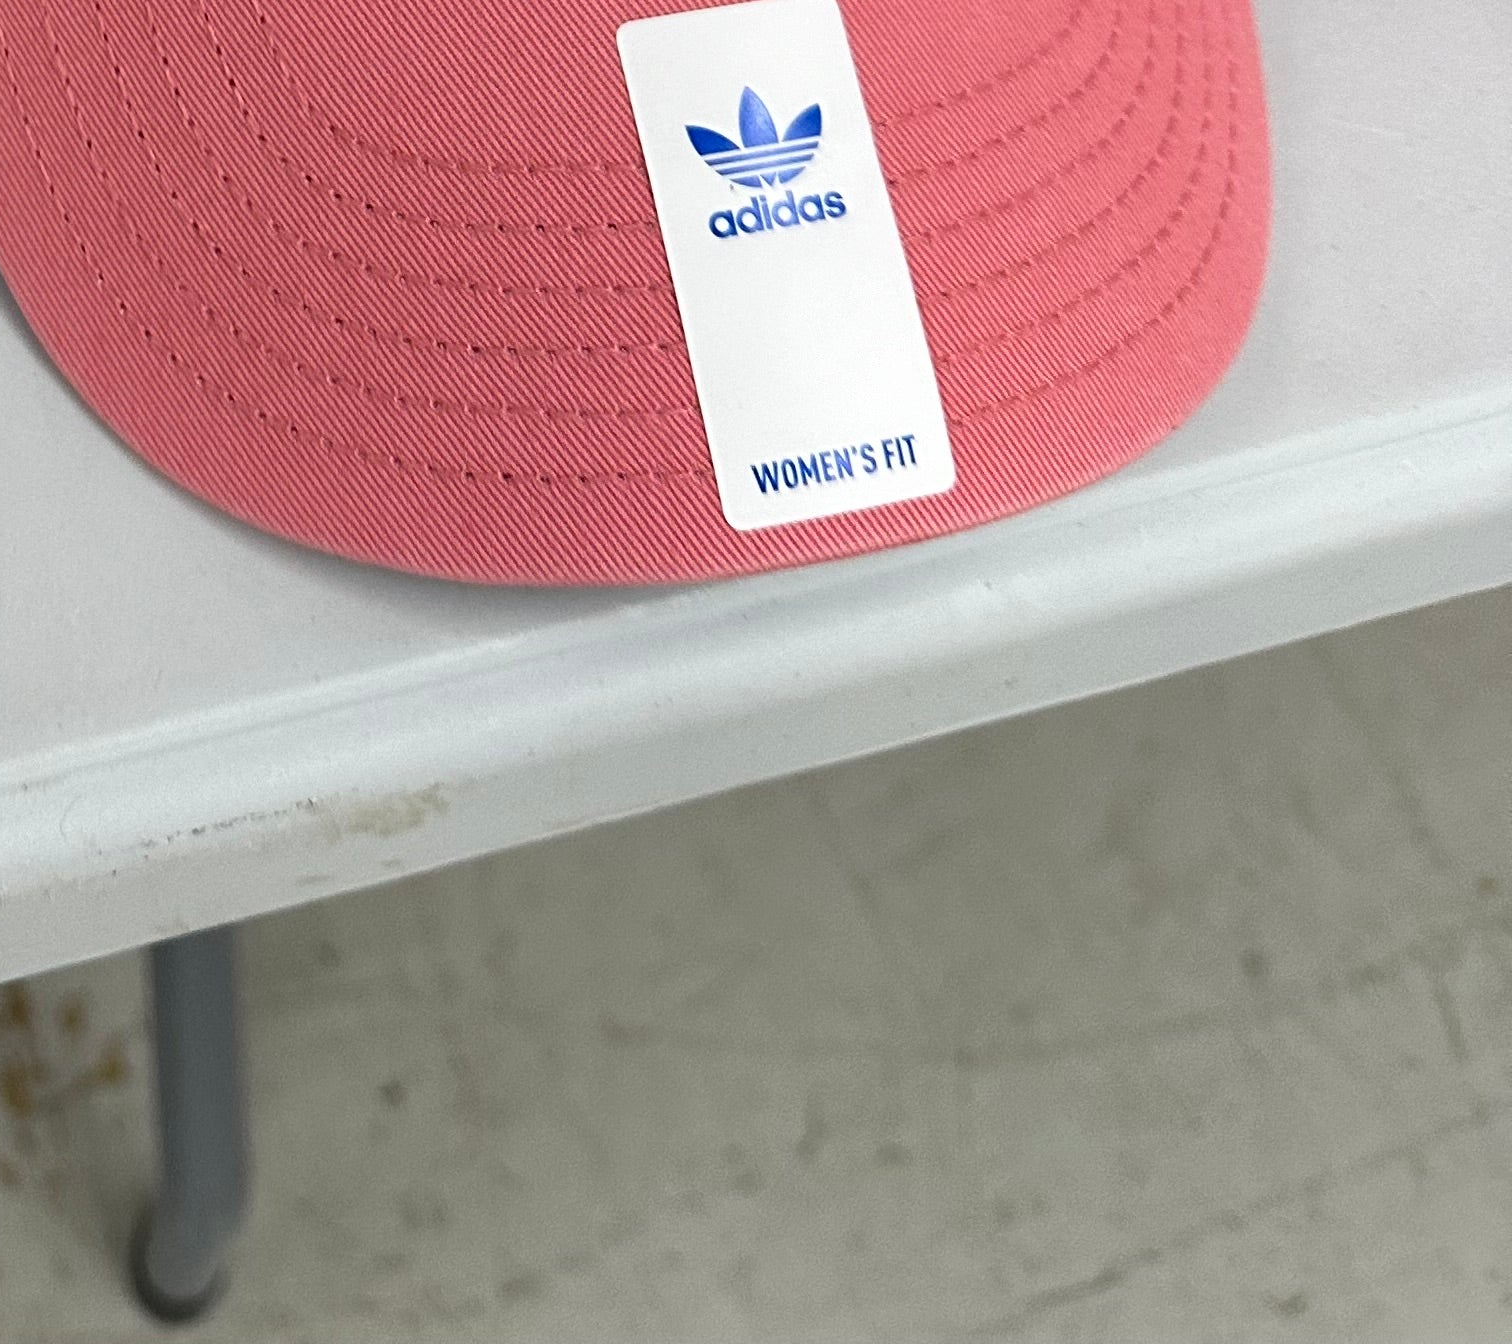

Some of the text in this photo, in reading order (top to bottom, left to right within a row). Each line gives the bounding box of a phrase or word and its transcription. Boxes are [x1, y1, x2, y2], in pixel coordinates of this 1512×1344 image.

[708, 188, 847, 239] adidas
[750, 434, 918, 495] WOMEN'S FIT
